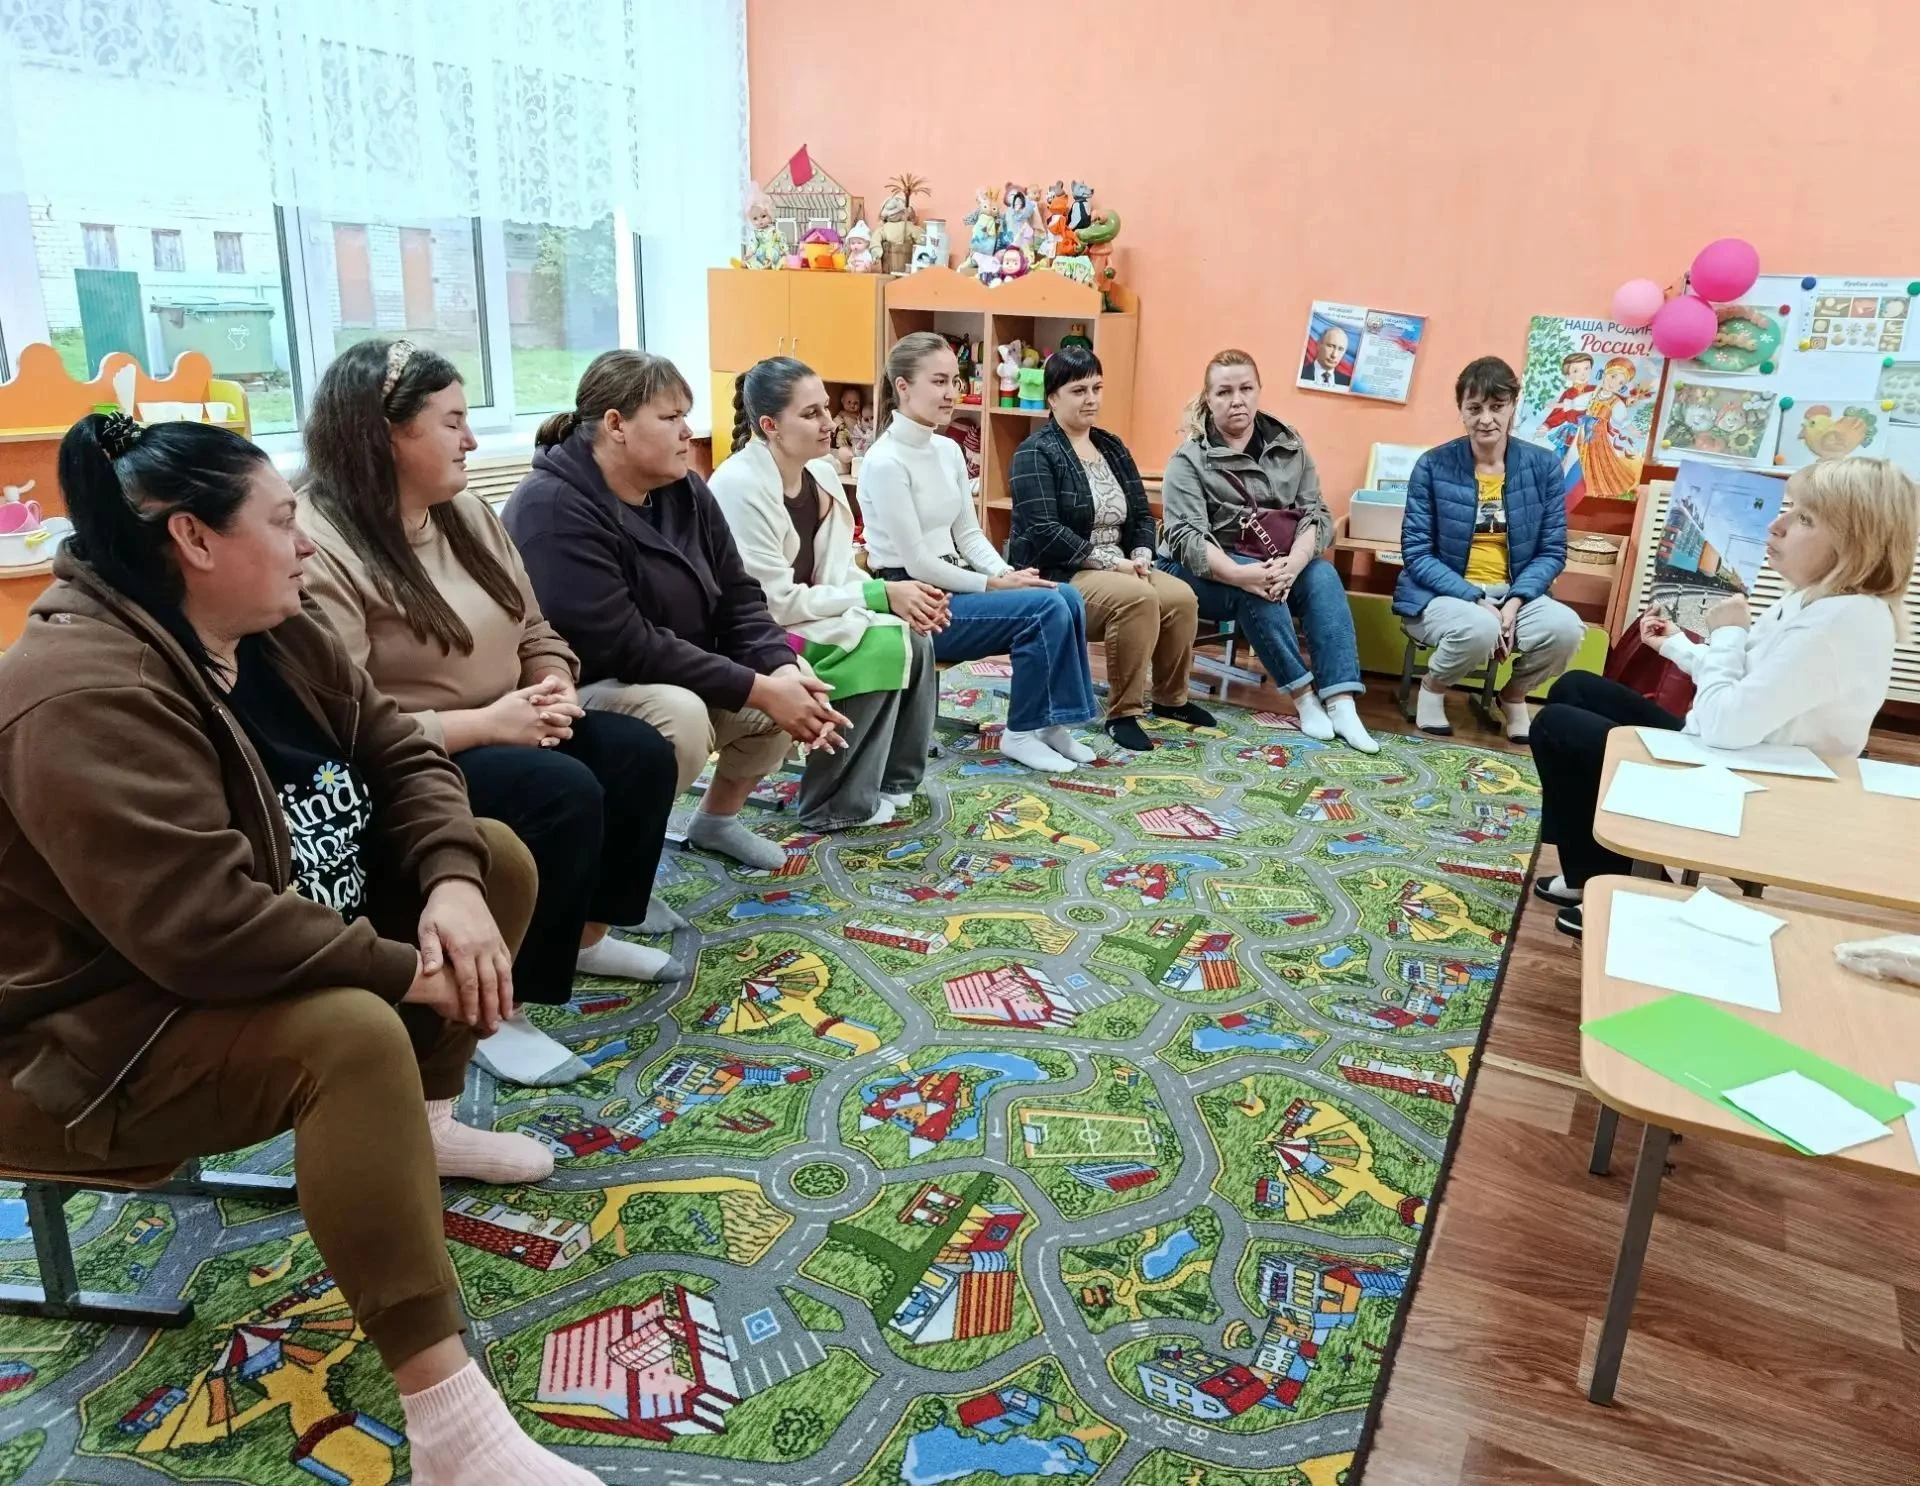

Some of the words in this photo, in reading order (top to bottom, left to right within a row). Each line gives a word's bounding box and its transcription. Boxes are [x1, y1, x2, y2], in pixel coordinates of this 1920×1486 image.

[1564, 319, 1604, 332] НАША
[1607, 322, 1653, 336] РОДИН
[1580, 333, 1654, 357] Россия!
[1142, 1411, 1209, 1441] BUS
